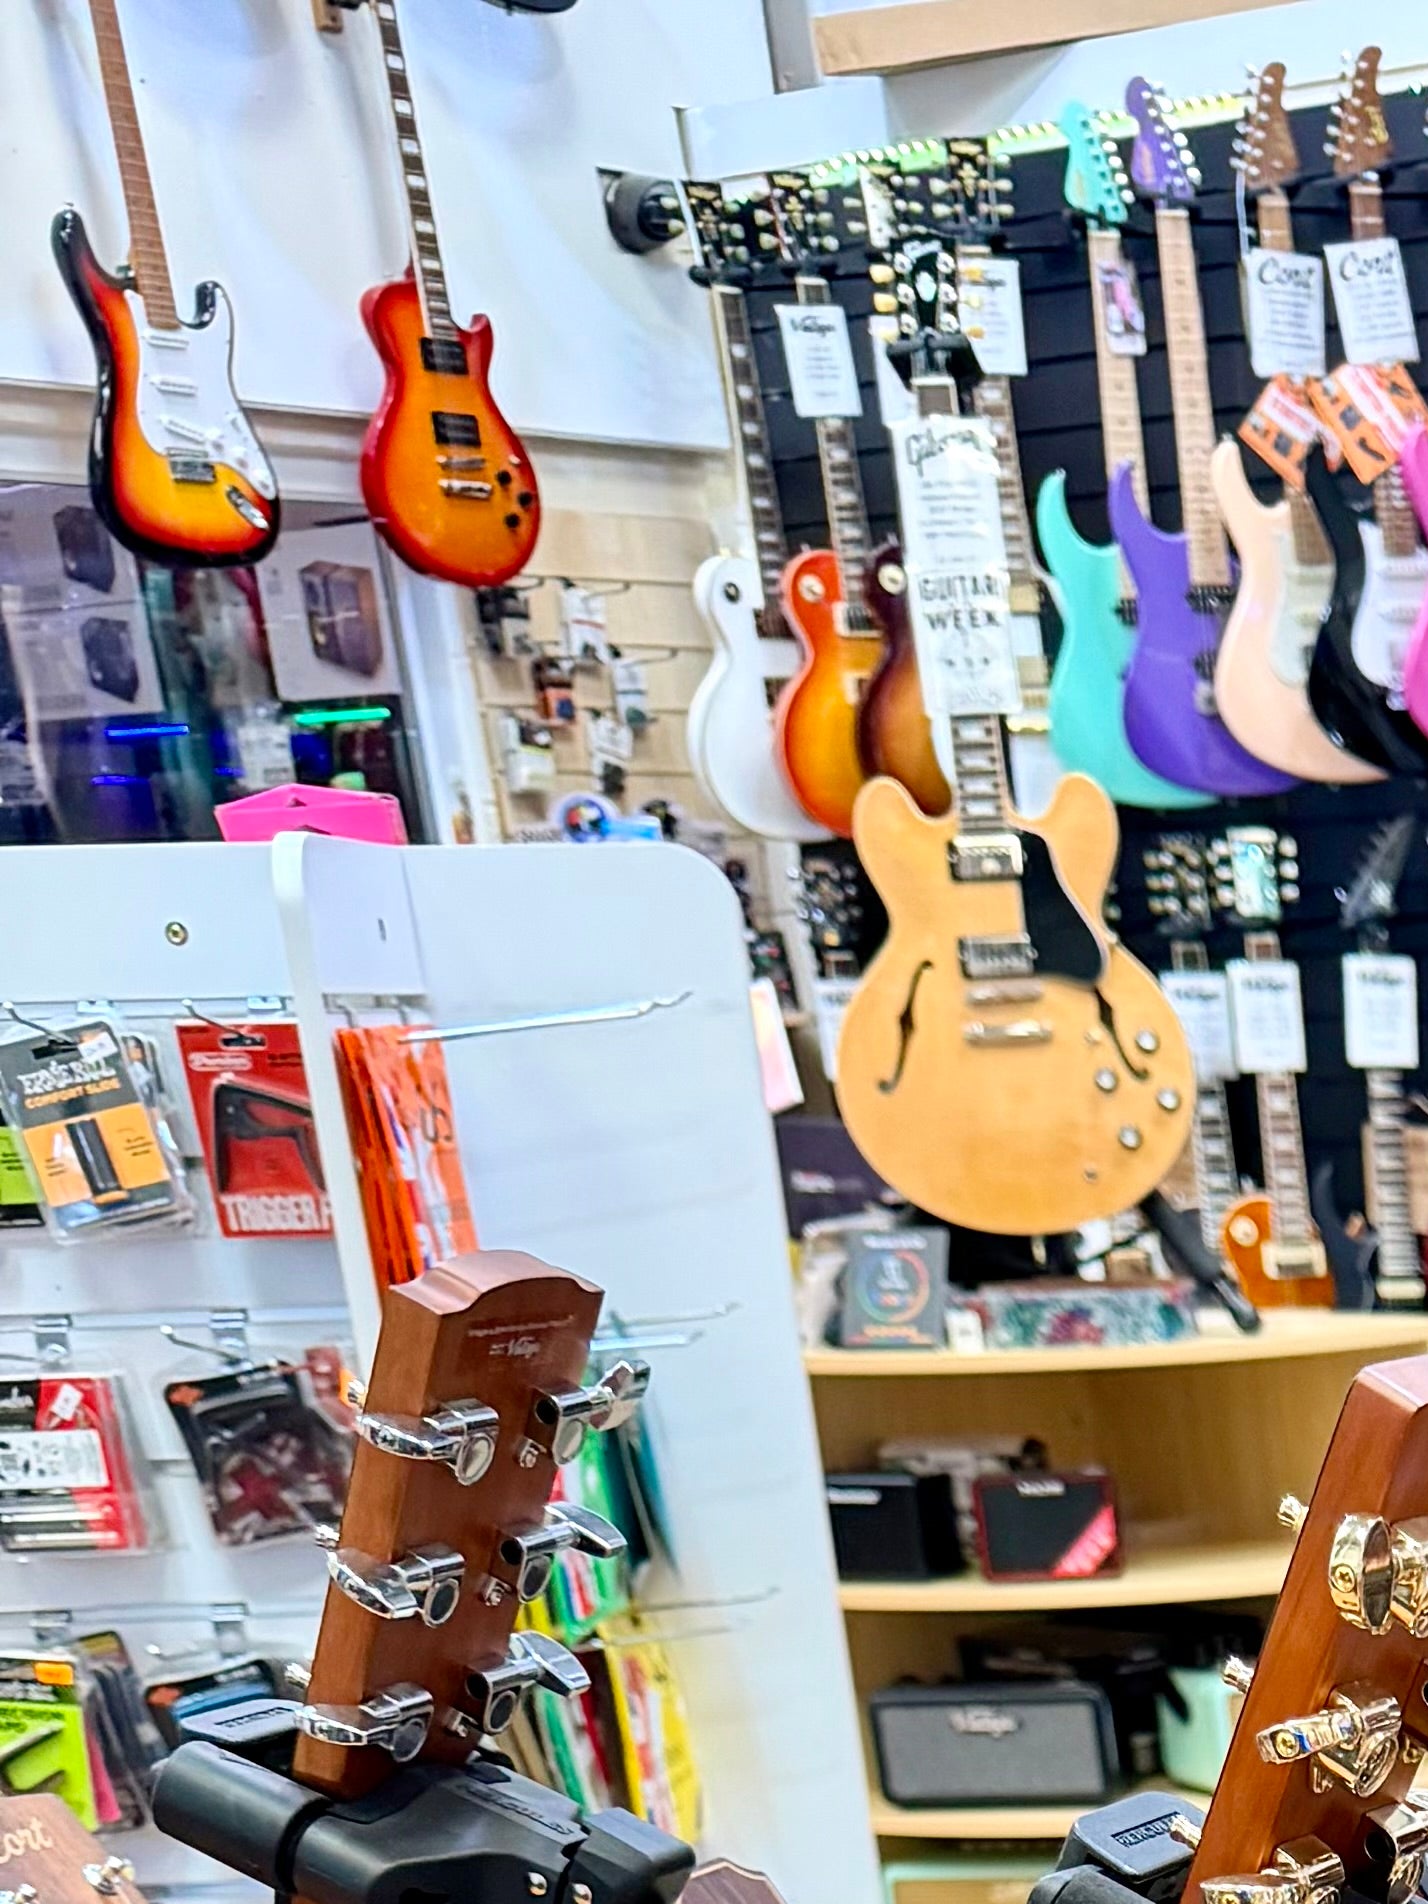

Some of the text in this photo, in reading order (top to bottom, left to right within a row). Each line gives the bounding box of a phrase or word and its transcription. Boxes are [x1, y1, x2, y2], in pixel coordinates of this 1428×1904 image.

[1258, 257, 1316, 289] Cort
[1340, 252, 1396, 281] Cort
[221, 1193, 315, 1232] TRIGGER
[1116, 1815, 1188, 1849] HERCUL
